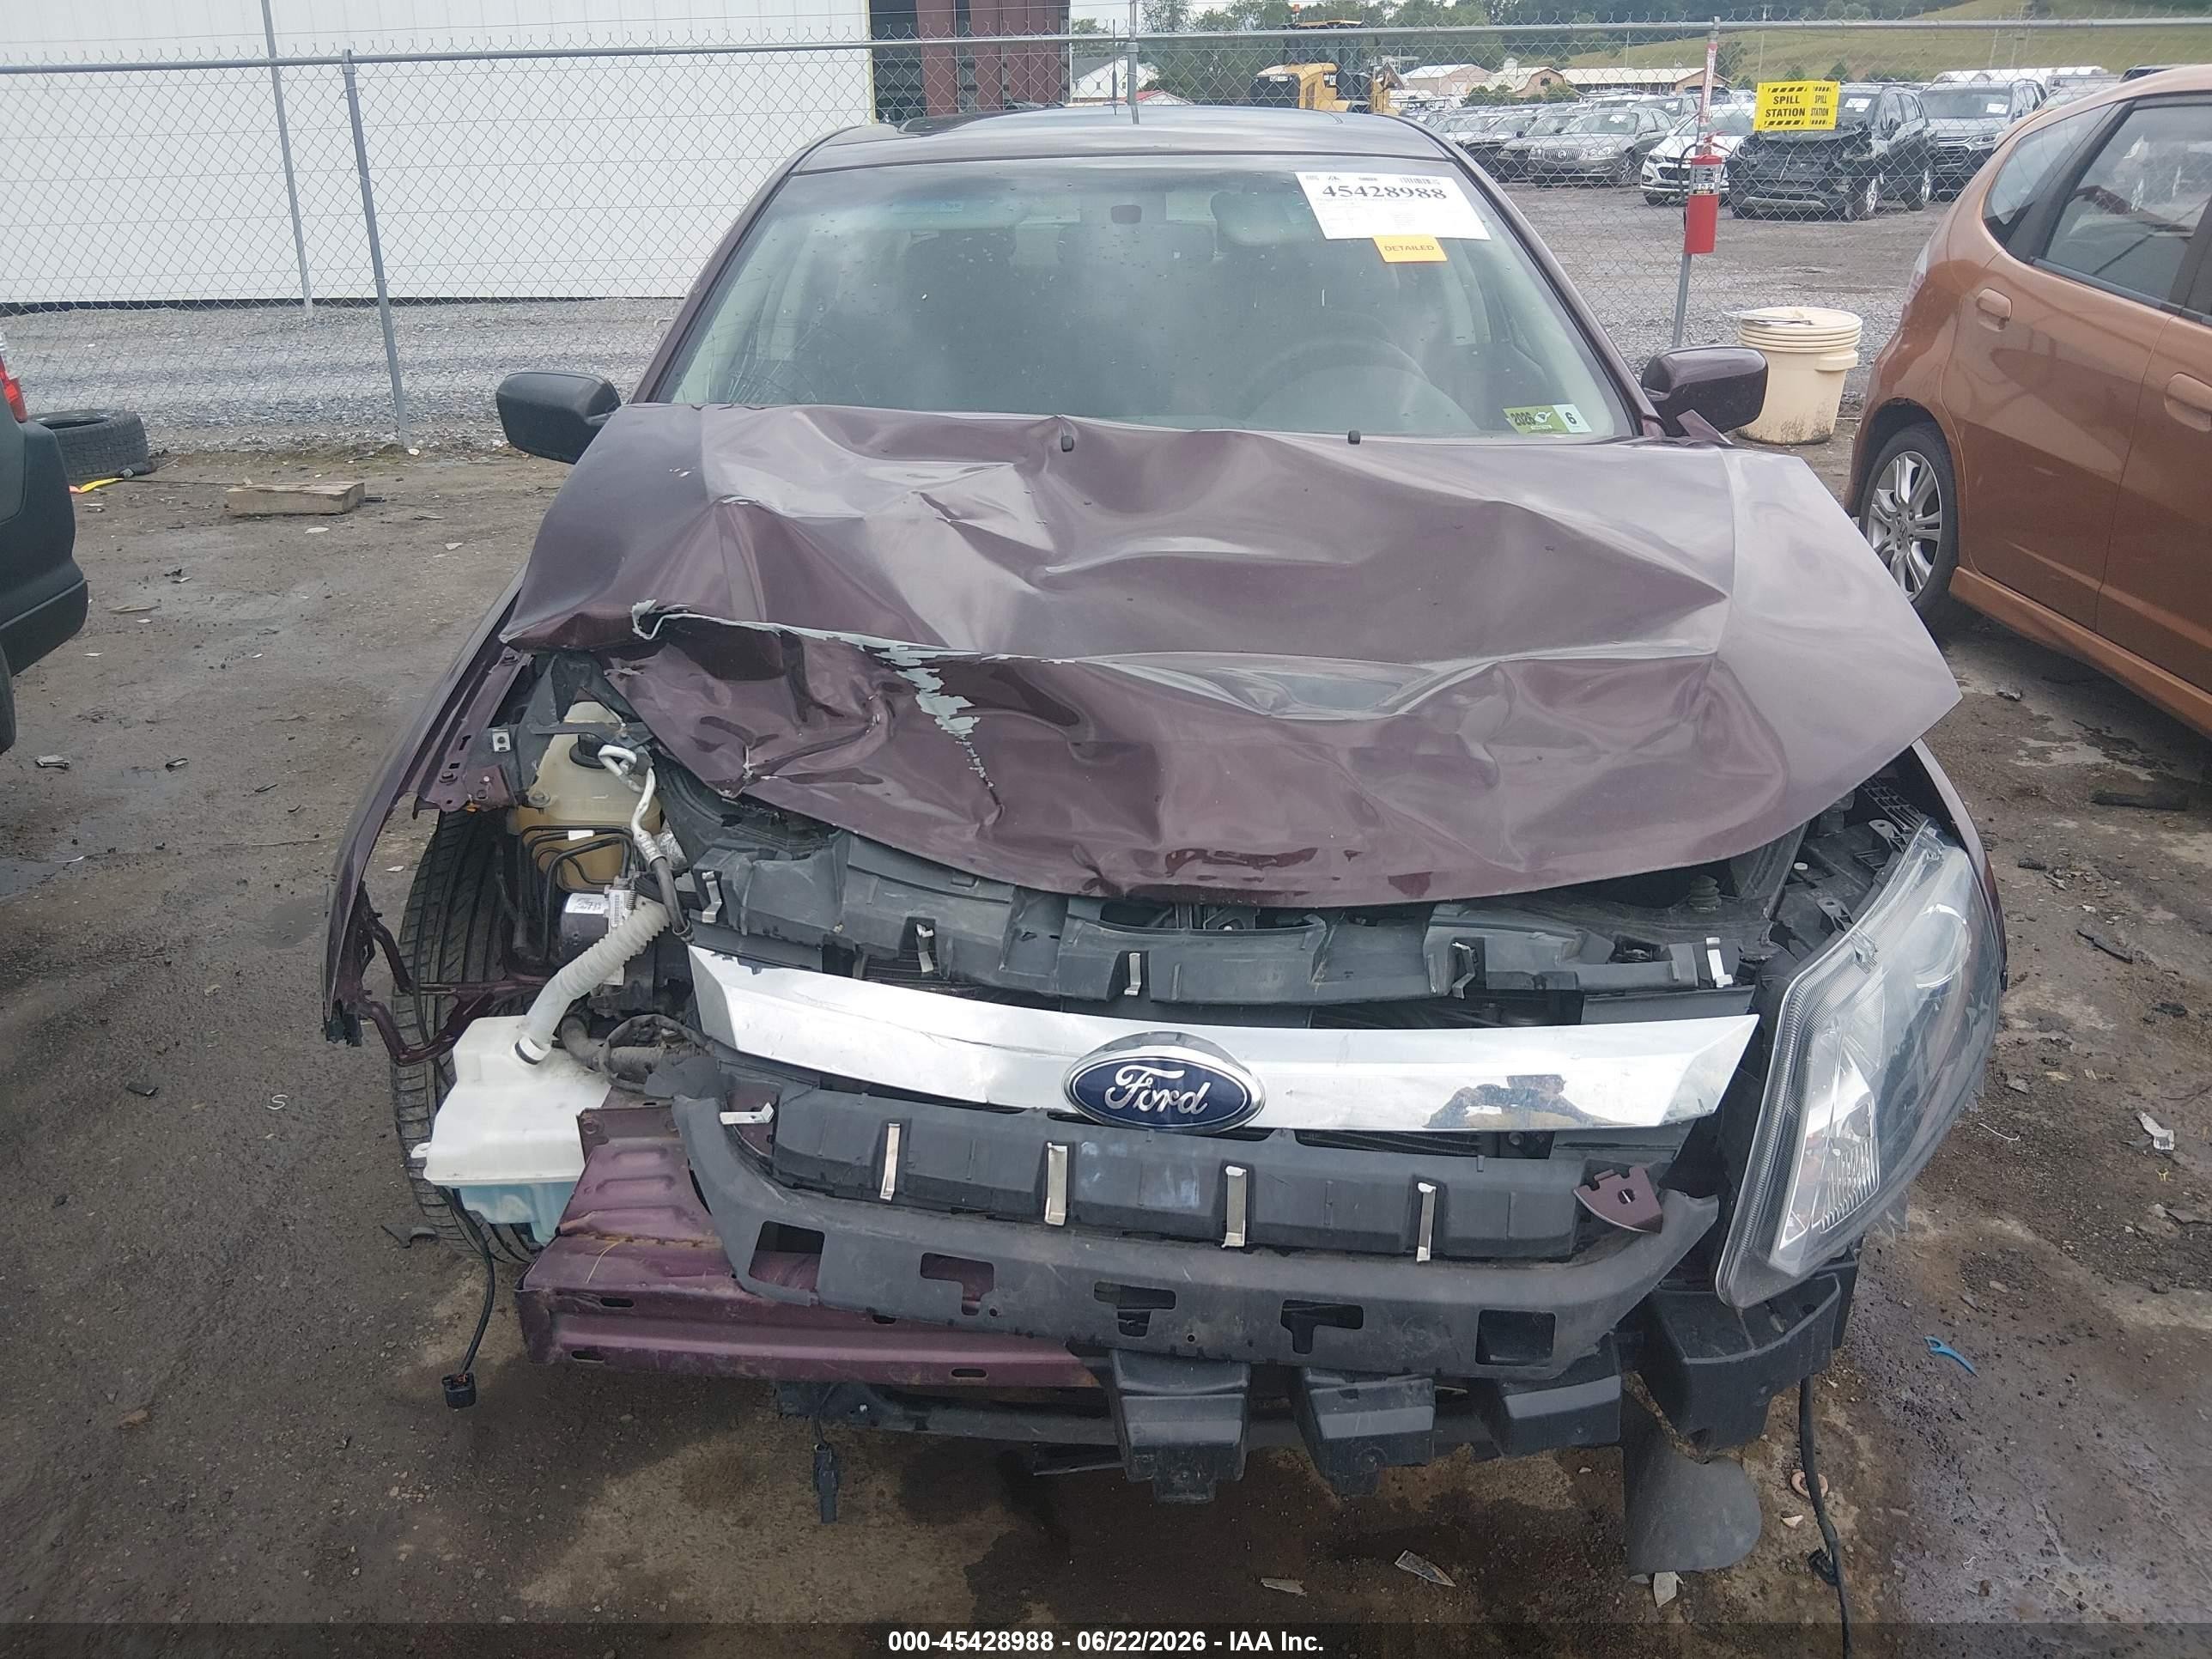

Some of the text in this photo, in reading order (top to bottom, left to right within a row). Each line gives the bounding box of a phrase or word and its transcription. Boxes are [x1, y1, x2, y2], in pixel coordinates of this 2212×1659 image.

[1773, 95, 1800, 105] SPILL
[1814, 94, 1827, 103] SPILL
[1765, 108, 1805, 118] STATION
[1322, 185, 1447, 199] 45428988
[1511, 412, 1536, 426] 2026
[1565, 412, 1577, 424] 6
[1104, 1065, 1211, 1115] Ford
